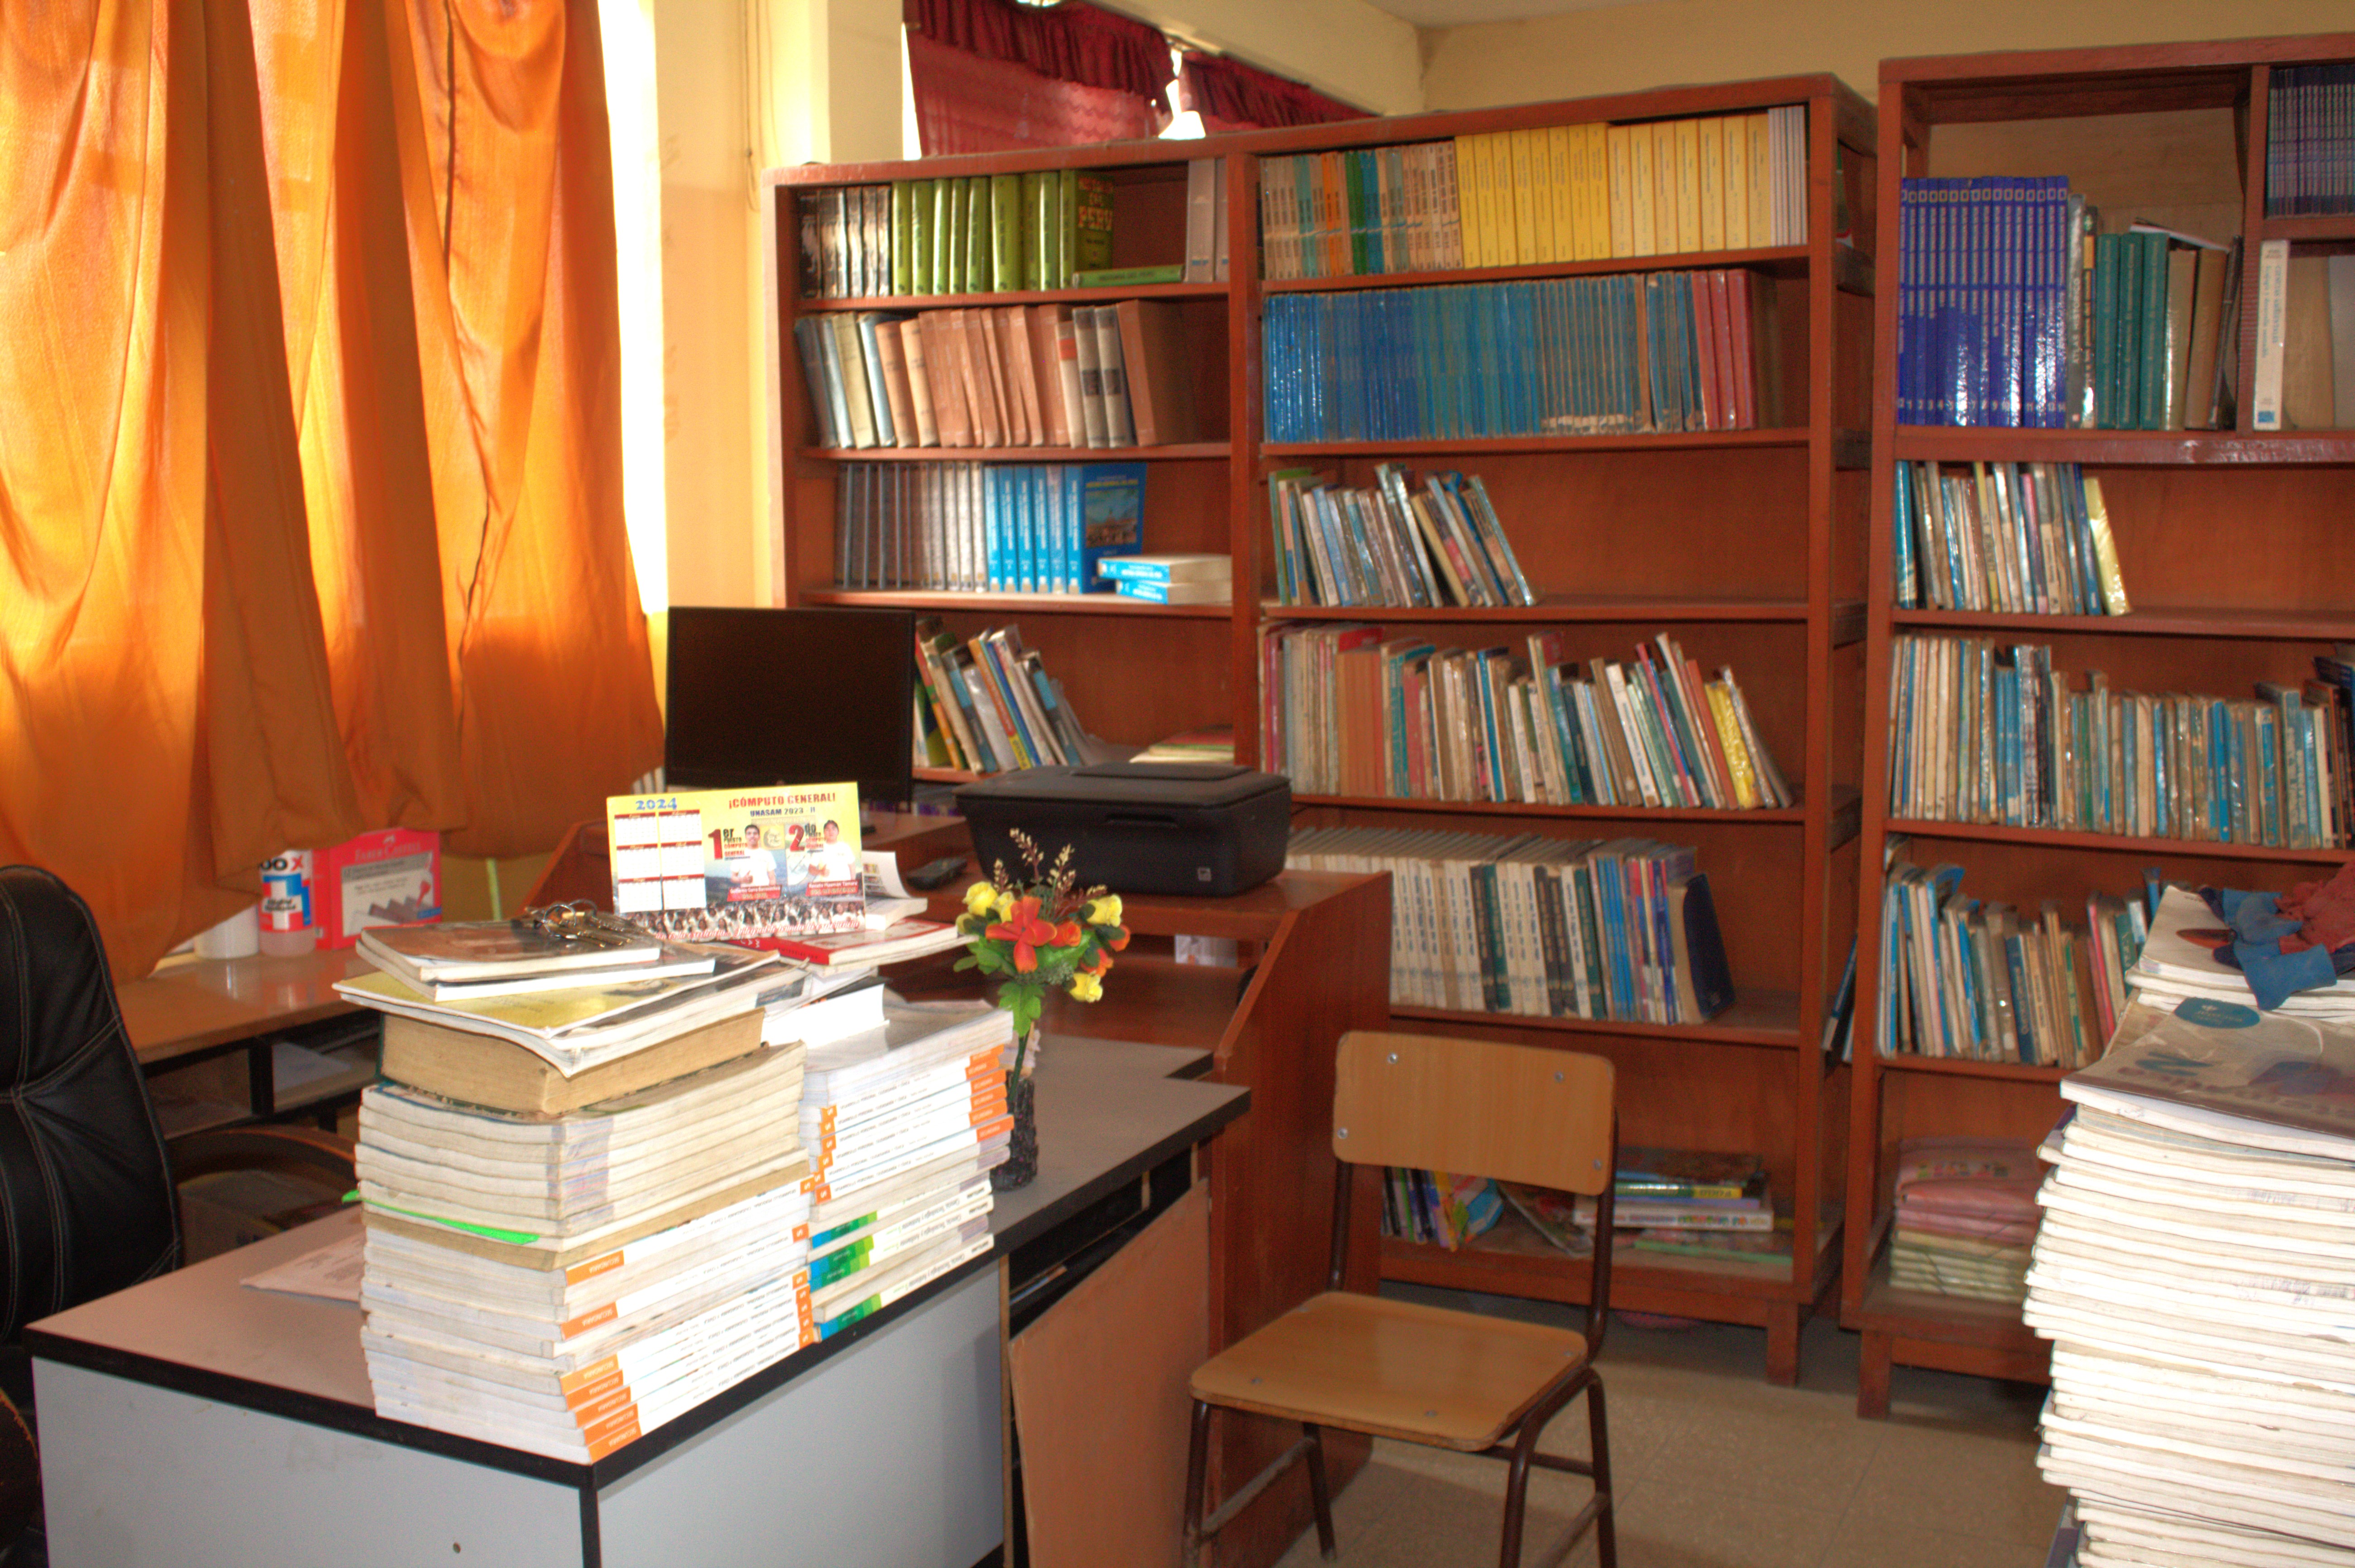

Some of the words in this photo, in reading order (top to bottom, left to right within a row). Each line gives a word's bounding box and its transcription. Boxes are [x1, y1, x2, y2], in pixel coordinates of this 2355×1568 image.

[2072, 335, 2080, 364] ATLAS
[636, 798, 677, 810] 2024
[729, 796, 784, 809] ¡CÓMPUTO
[788, 793, 835, 804] GENERAL!
[750, 809, 782, 817] UNASAM
[824, 1123, 832, 1131] S
[814, 1174, 821, 1182] S
[795, 1229, 804, 1237] S
[795, 1276, 804, 1284] S
[801, 1334, 809, 1342] S
